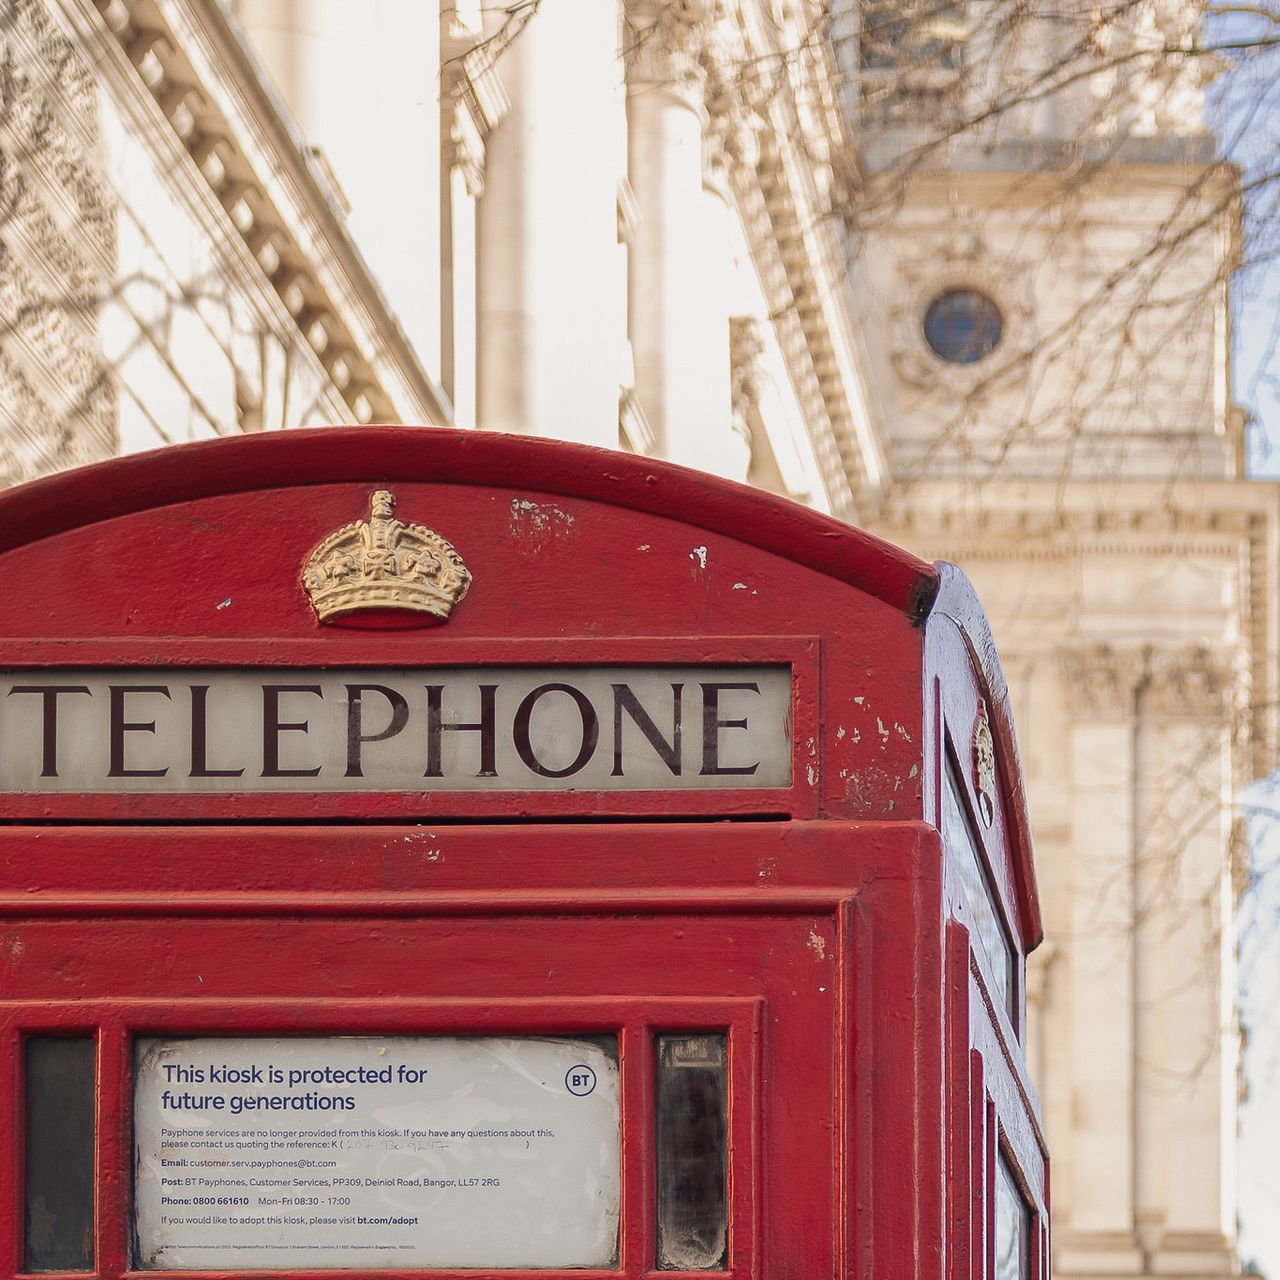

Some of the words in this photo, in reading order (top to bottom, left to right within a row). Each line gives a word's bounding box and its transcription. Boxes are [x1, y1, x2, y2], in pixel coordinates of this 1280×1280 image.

[7, 682, 762, 778] TELEPHONE
[162, 1064, 205, 1083] This
[210, 1064, 264, 1084] kiosk
[268, 1064, 284, 1084] is
[289, 1064, 392, 1088] protected
[396, 1064, 428, 1084] for
[572, 1074, 590, 1086] BT
[161, 1090, 226, 1110] future
[230, 1092, 356, 1114] generations
[161, 1128, 204, 1138] Payphone
[205, 1128, 240, 1137] services
[269, 1129, 298, 1139] longer
[298, 1129, 337, 1139] provided
[338, 1128, 359, 1138] from
[360, 1129, 376, 1138] this
[377, 1129, 402, 1138] kiosk.
[403, 1128, 410, 1137] If
[410, 1130, 427, 1139] you
[428, 1129, 449, 1138] have
[450, 1130, 466, 1139] any
[467, 1129, 509, 1139] questions
[510, 1128, 536, 1138] about
[537, 1128, 555, 1138] this,
[161, 1140, 189, 1151] please
[190, 1140, 223, 1148] contact
[235, 1140, 269, 1150] quoting
[270, 1140, 285, 1148] the
[286, 1140, 330, 1149] reference:
[161, 1158, 189, 1167] Email:
[190, 1159, 337, 1170] customer.serv.payphones@bt.com
[161, 1178, 184, 1186] Post:
[184, 1178, 197, 1186] BT
[198, 1178, 248, 1188] Payphones,
[249, 1178, 292, 1187] Customer
[292, 1178, 331, 1188] Services,
[332, 1178, 364, 1187] PP309,
[365, 1178, 396, 1187] Deiniol
[396, 1178, 422, 1188] Road,
[423, 1178, 457, 1188] Bangor,
[458, 1178, 480, 1187] LL57
[481, 1178, 500, 1187] 2RG
[161, 1196, 192, 1206] Phone:
[192, 1197, 216, 1205] 0800
[217, 1197, 250, 1205] 661610
[258, 1197, 293, 1206] Mon-Fri
[294, 1197, 319, 1206] 08:30
[327, 1197, 351, 1206] 17:00
[161, 1216, 167, 1224] If
[168, 1218, 184, 1226] you
[185, 1216, 212, 1224] would
[212, 1216, 228, 1224] like
[229, 1216, 238, 1224] to
[239, 1216, 265, 1226] adopt
[266, 1216, 282, 1224] this
[284, 1216, 308, 1226] kiosk,
[309, 1216, 338, 1226] please
[338, 1216, 356, 1225] visit
[357, 1216, 419, 1226] bt.com/adopt
